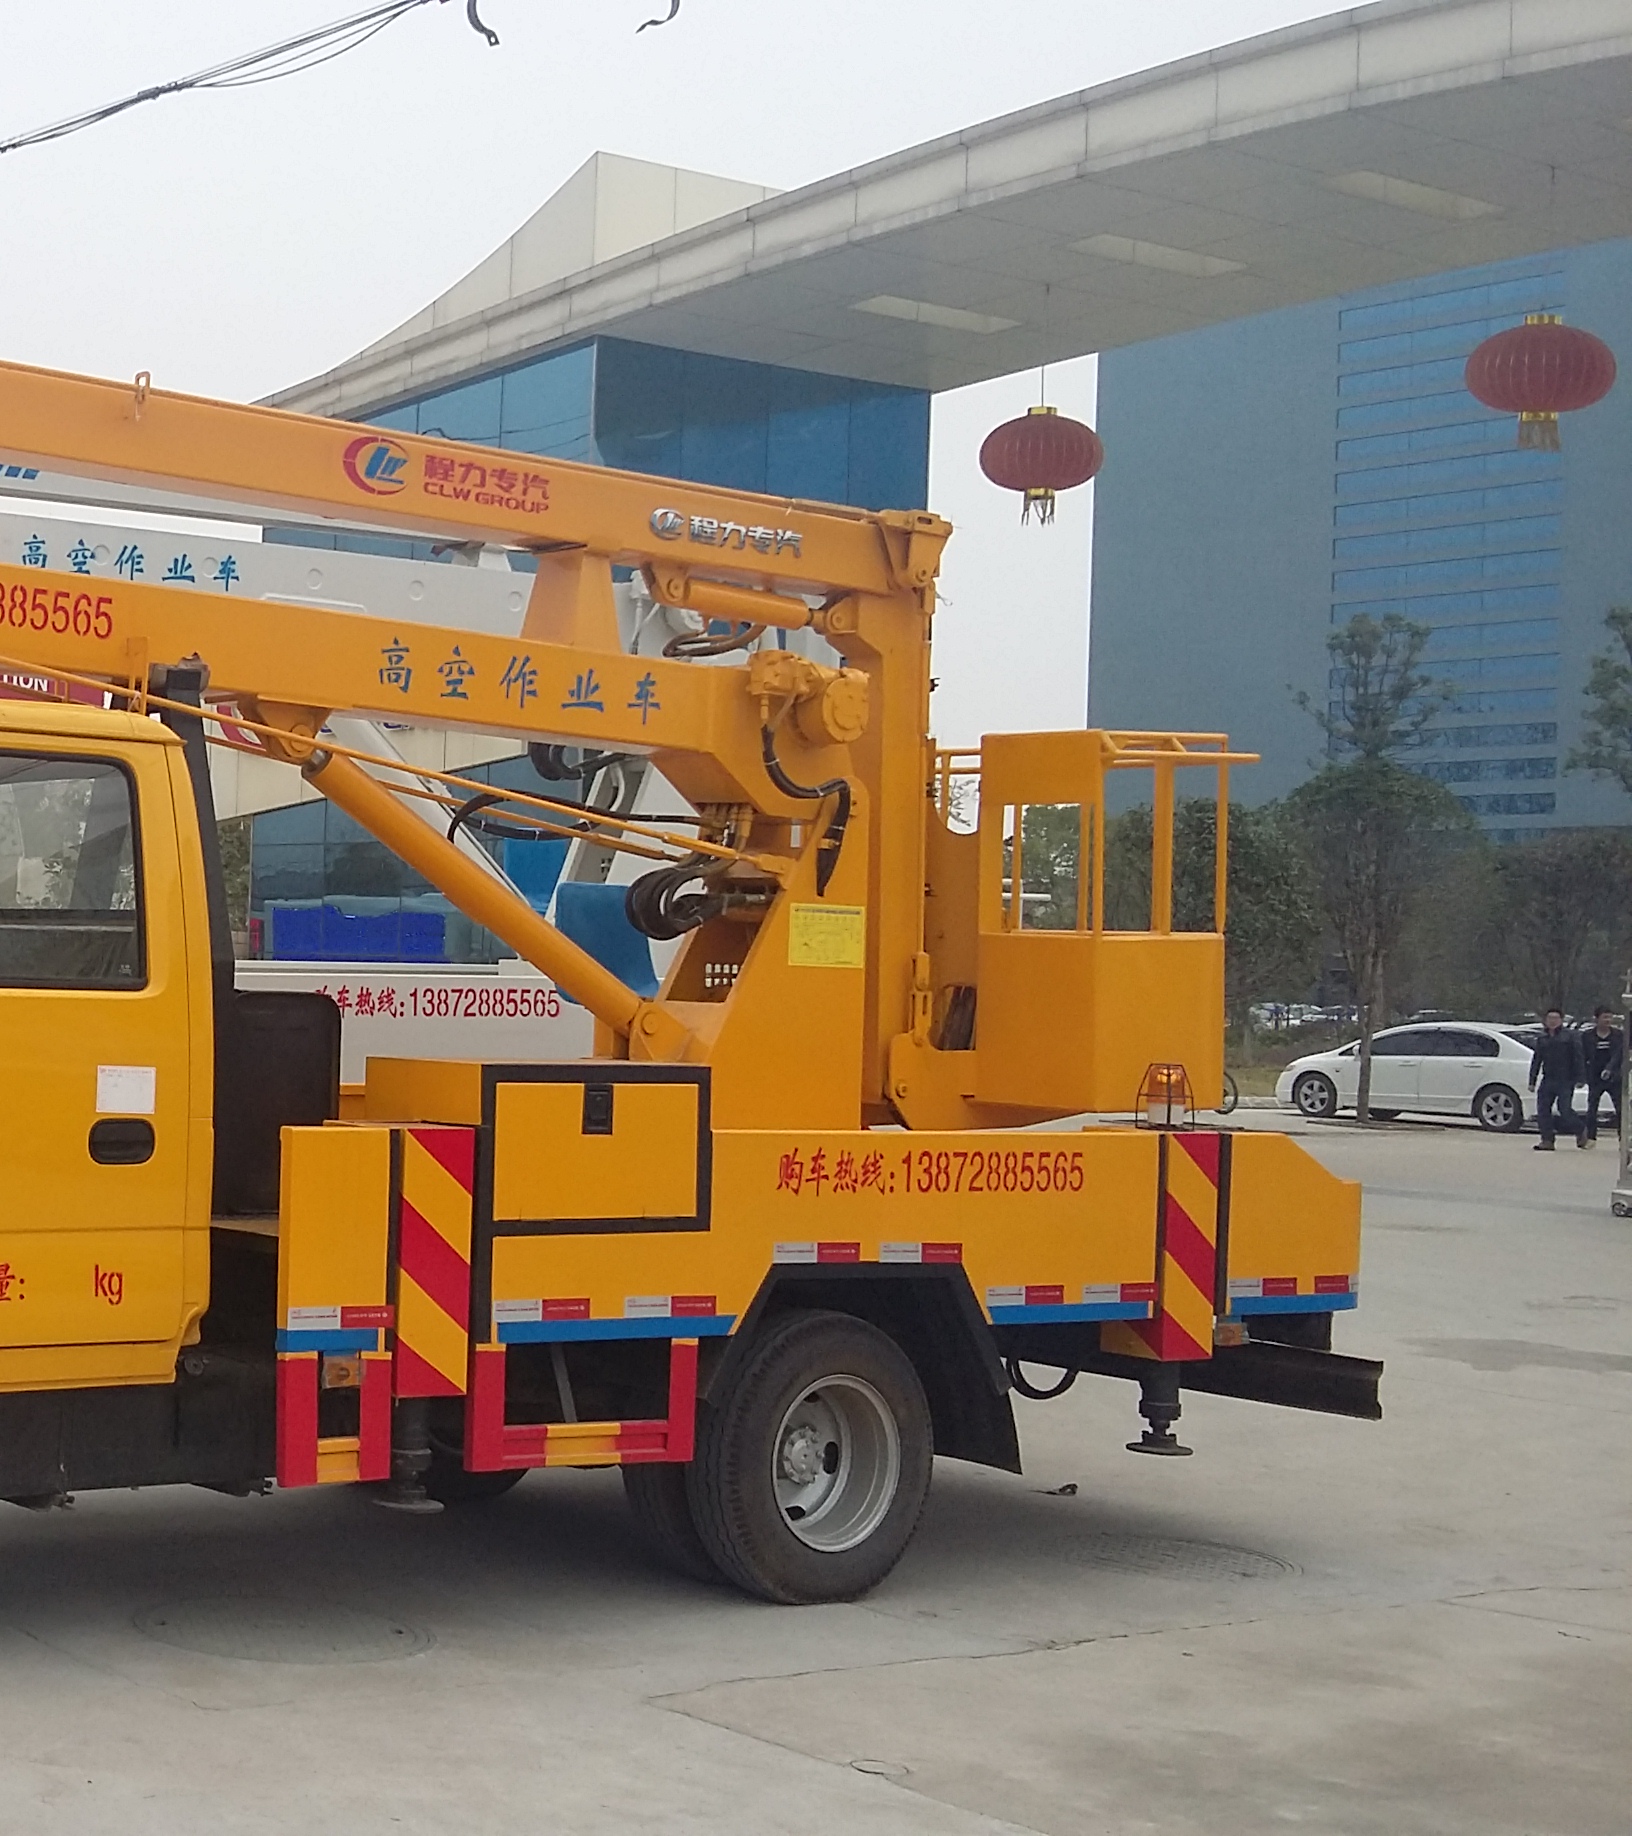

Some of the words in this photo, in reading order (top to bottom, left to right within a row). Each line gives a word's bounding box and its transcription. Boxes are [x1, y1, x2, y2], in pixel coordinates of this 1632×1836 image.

[423, 482, 470, 502] CLW
[474, 491, 550, 514] GROUP
[424, 454, 550, 500] 程力专汽
[689, 515, 803, 559] 程力专汽
[21, 535, 240, 590] 高空作业车
[378, 636, 662, 726] 高空作业车
[316, 984, 561, 1019] 车热线:13872885565
[93, 1264, 124, 1306] kg
